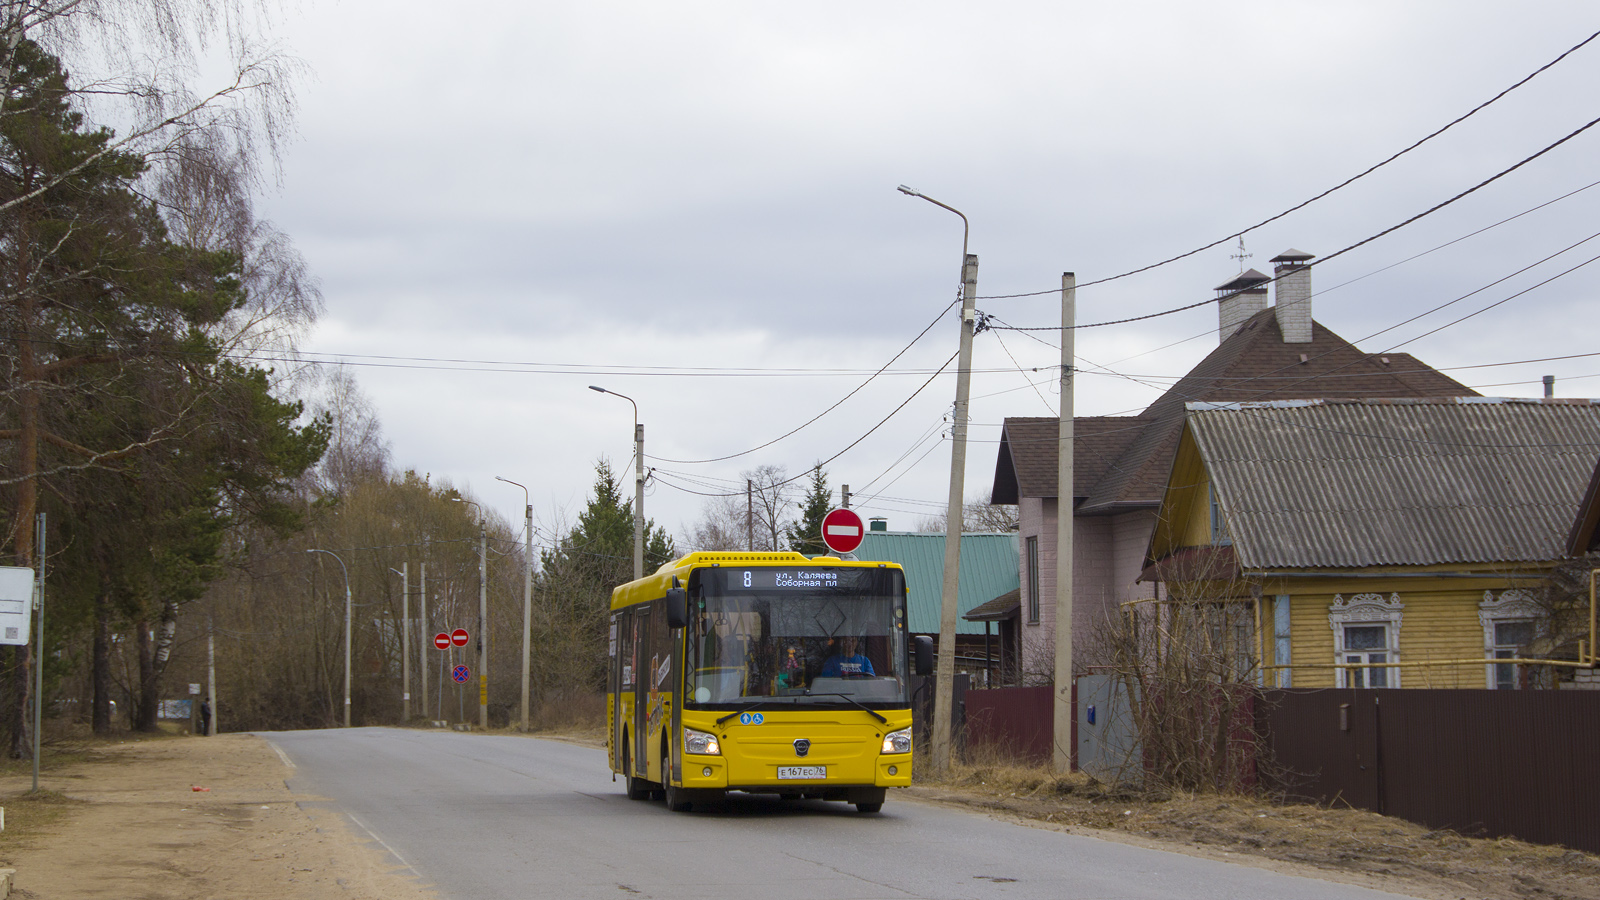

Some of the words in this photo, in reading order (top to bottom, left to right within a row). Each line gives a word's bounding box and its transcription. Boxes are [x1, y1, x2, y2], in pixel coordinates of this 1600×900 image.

[743, 571, 752, 588] 8
[797, 571, 837, 580] Каляева
[775, 579, 821, 587] Соборная
